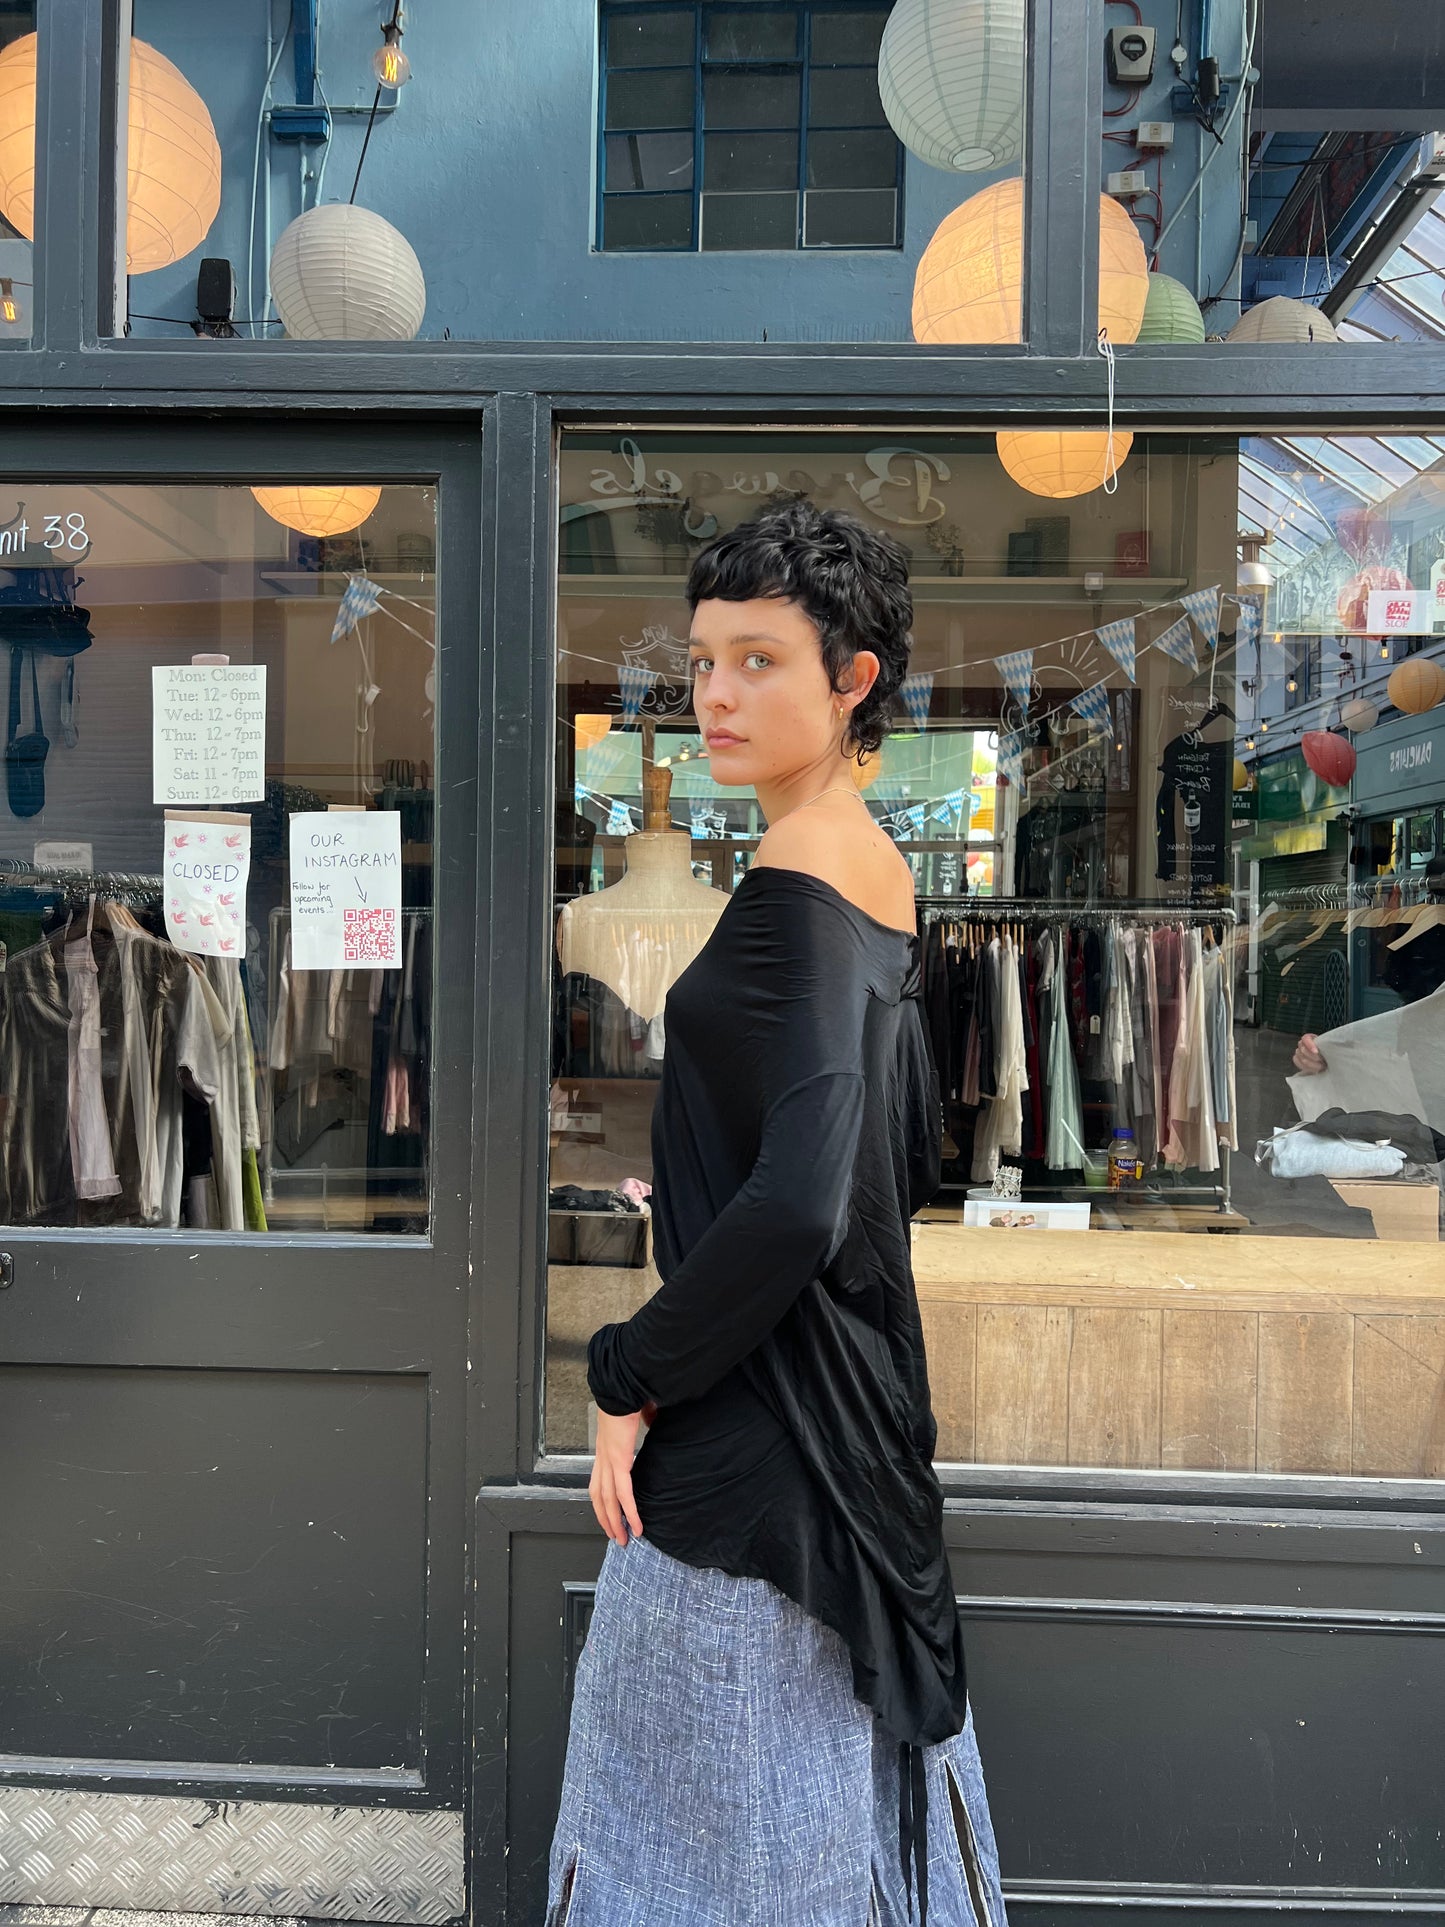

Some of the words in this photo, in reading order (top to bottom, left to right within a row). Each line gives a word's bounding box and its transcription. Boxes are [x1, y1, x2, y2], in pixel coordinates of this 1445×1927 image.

[0, 519, 30, 555] nit
[43, 513, 89, 550] 38
[1385, 620, 1408, 628] SLOE
[169, 669, 205, 682] Mon:
[211, 668, 257, 682] Closed
[167, 689, 198, 702] Tue:
[204, 688, 219, 702] 12
[230, 688, 260, 704] 6pm
[164, 708, 203, 721] Wed:
[208, 707, 223, 721] 12
[234, 708, 264, 724] 6pm
[161, 728, 196, 741] Thu:
[207, 727, 222, 741] 12
[234, 727, 261, 743] 7pm
[174, 748, 197, 760] Fri:
[204, 746, 218, 760] 12
[230, 747, 258, 763] 7pm
[173, 767, 199, 780] Sat:
[204, 767, 217, 780] 11
[231, 767, 258, 782] 7pm
[167, 787, 199, 800] Sun:
[205, 786, 220, 799] 12
[231, 786, 260, 801] 6pm
[310, 832, 345, 847] OUR
[305, 852, 397, 868] INSTAGRAM
[172, 863, 239, 882] CLOSED
[292, 881, 314, 891] Follow
[317, 881, 330, 896] for
[294, 895, 333, 908] upcoming
